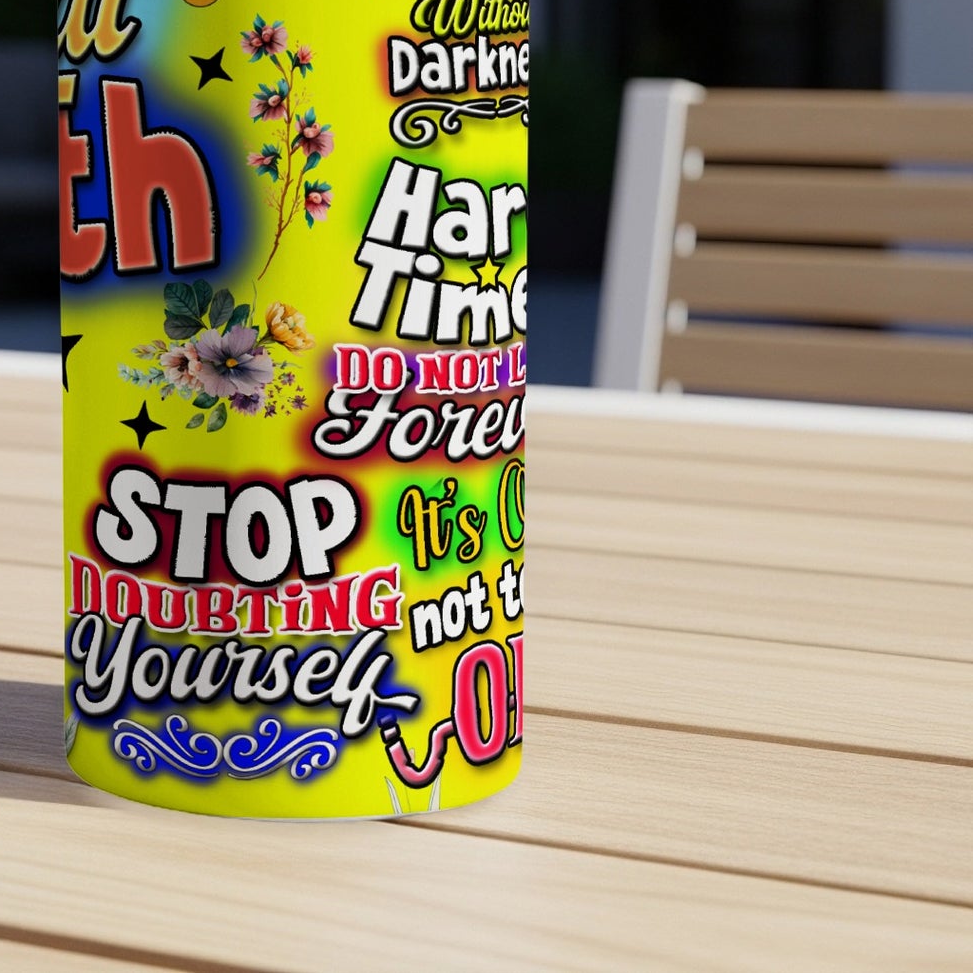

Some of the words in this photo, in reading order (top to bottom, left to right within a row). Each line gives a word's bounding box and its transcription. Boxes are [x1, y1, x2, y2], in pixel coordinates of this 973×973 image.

[334, 344, 407, 394] DO
[416, 349, 502, 394] NOT
[93, 464, 361, 587] STOP
[398, 478, 488, 570] It's
[409, 572, 491, 653] not
[67, 611, 421, 739] Yourself
